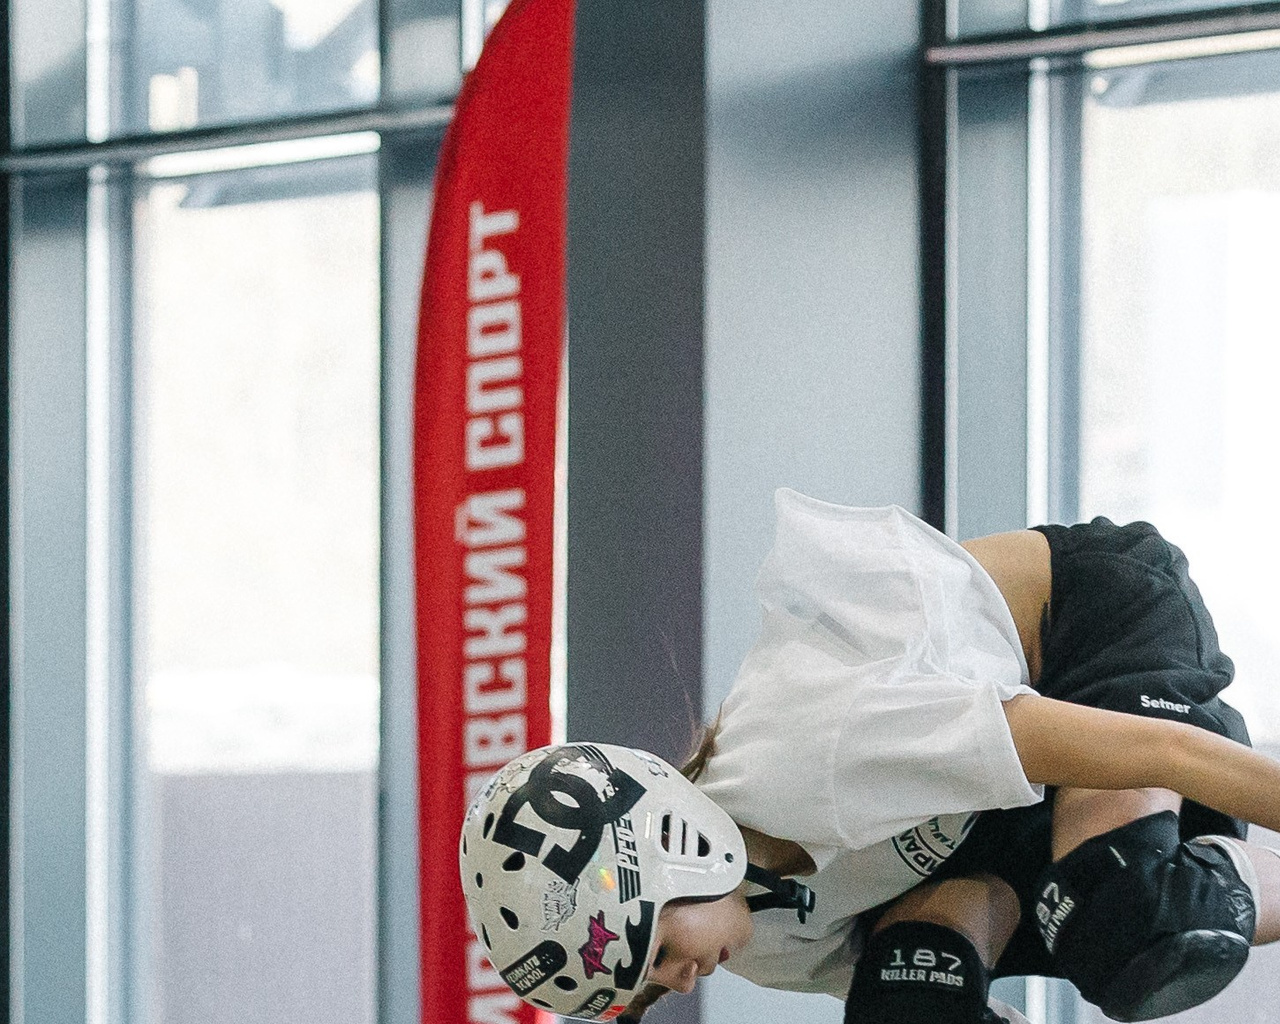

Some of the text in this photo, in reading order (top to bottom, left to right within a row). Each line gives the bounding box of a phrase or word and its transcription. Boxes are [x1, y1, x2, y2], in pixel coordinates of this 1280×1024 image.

[464, 200, 526, 471] СПОРТ
[889, 949, 962, 970] 187
[881, 968, 964, 987] KILLER PADS
